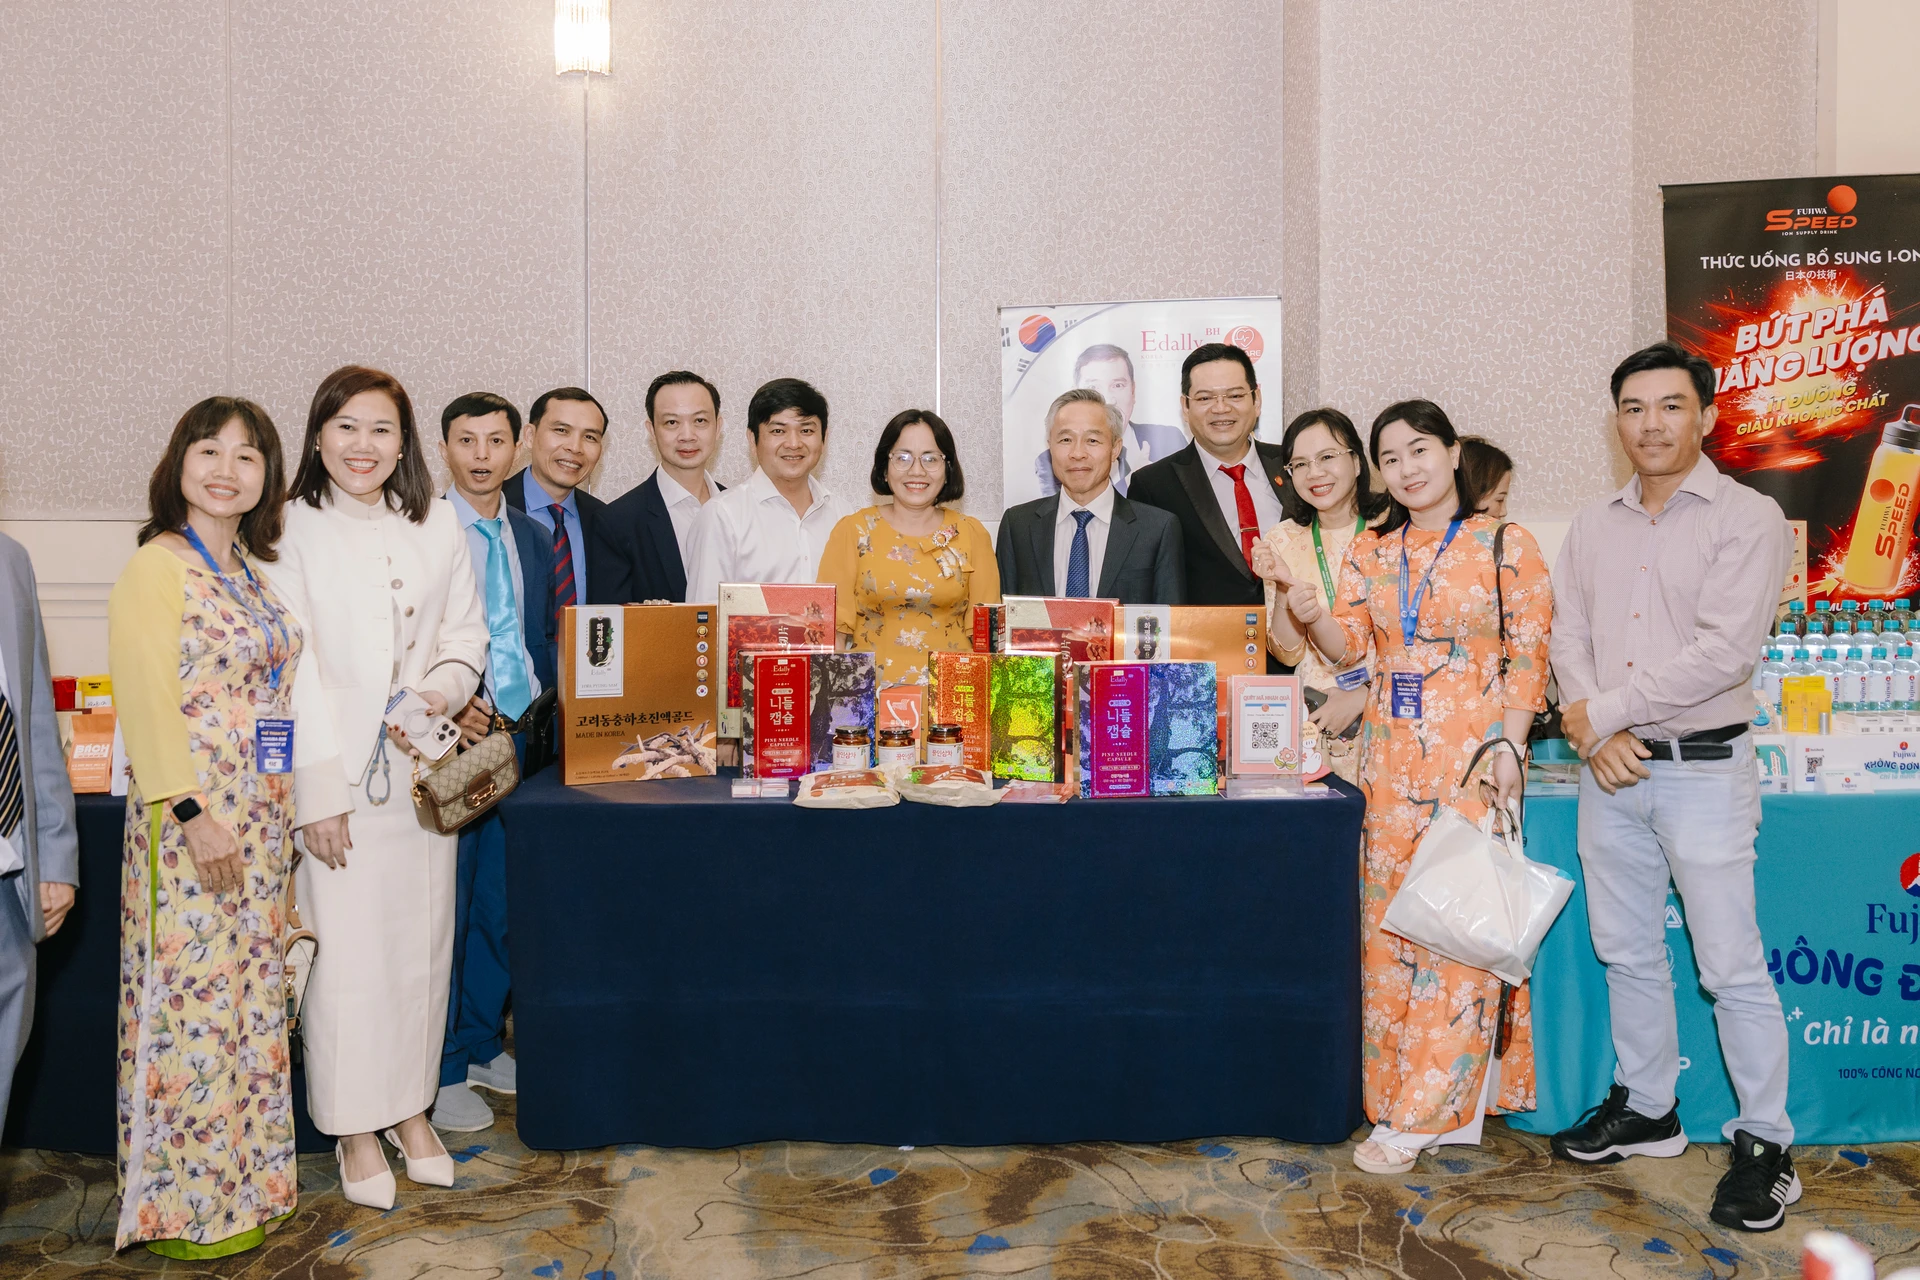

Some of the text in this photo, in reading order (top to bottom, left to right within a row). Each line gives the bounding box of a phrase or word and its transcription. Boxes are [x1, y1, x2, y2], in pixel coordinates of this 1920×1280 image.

[1797, 207, 1827, 215] FUJIWA
[1764, 209, 1858, 231] SPEED
[1700, 252, 1745, 269] THỨC
[1750, 249, 1801, 268] UỐNG
[1806, 247, 1829, 266] BỔ
[1834, 251, 1882, 265] SUNG
[1785, 269, 1837, 281] 日本の技術
[1811, 287, 1889, 339] PHÁ
[1205, 327, 1221, 336] BH
[1714, 358, 1804, 395] ĂNG
[1736, 389, 1889, 436] GIÀU KHOÁNG CHẤT
[1875, 483, 1910, 560] SPEED
[773, 664, 790, 675] Edally
[770, 696, 795, 710] 니들
[575, 710, 695, 728] 고려동충하초진액골드
[769, 711, 795, 726] 캡슐
[1106, 708, 1133, 723] 니들
[604, 730, 626, 738] KOREA
[1106, 723, 1133, 739] 캡슐
[1893, 750, 1916, 759] Fujiwa
[1864, 758, 1920, 771] KHÔNG ĐƠN
[1768, 935, 1885, 996] HÔNG
[1861, 1017, 1890, 1045] là
[1838, 1067, 1868, 1079] 100%
[1871, 1065, 1903, 1079] CÔNG
